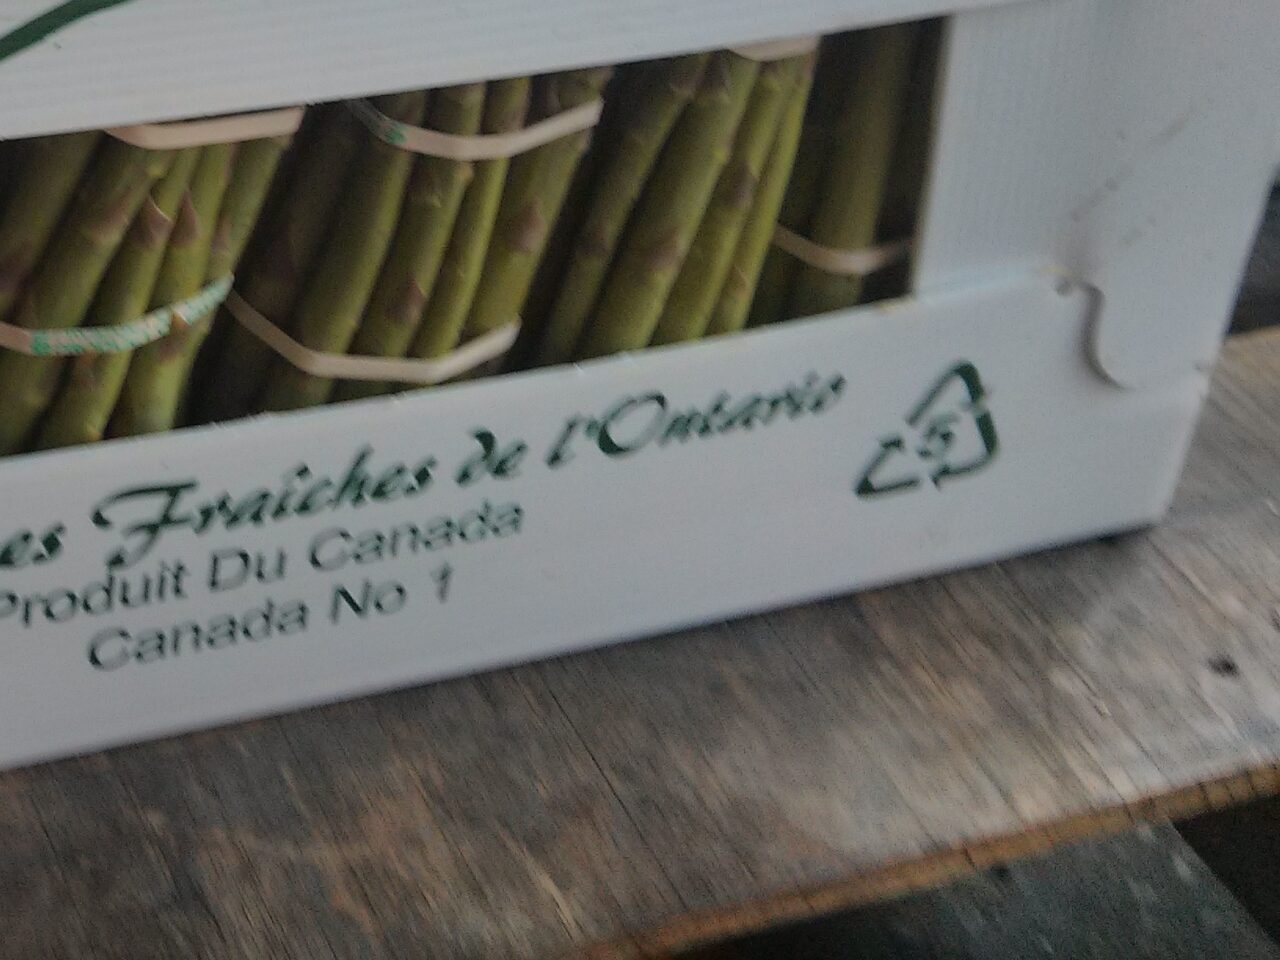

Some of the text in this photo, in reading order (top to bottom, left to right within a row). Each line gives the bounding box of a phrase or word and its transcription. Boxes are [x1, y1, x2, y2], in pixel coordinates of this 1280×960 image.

[455, 427, 529, 488] de
[545, 370, 848, 469] l'Ontario
[207, 545, 288, 594] Du
[307, 498, 525, 573] Canada
[86, 558, 455, 672] Canada No 1
